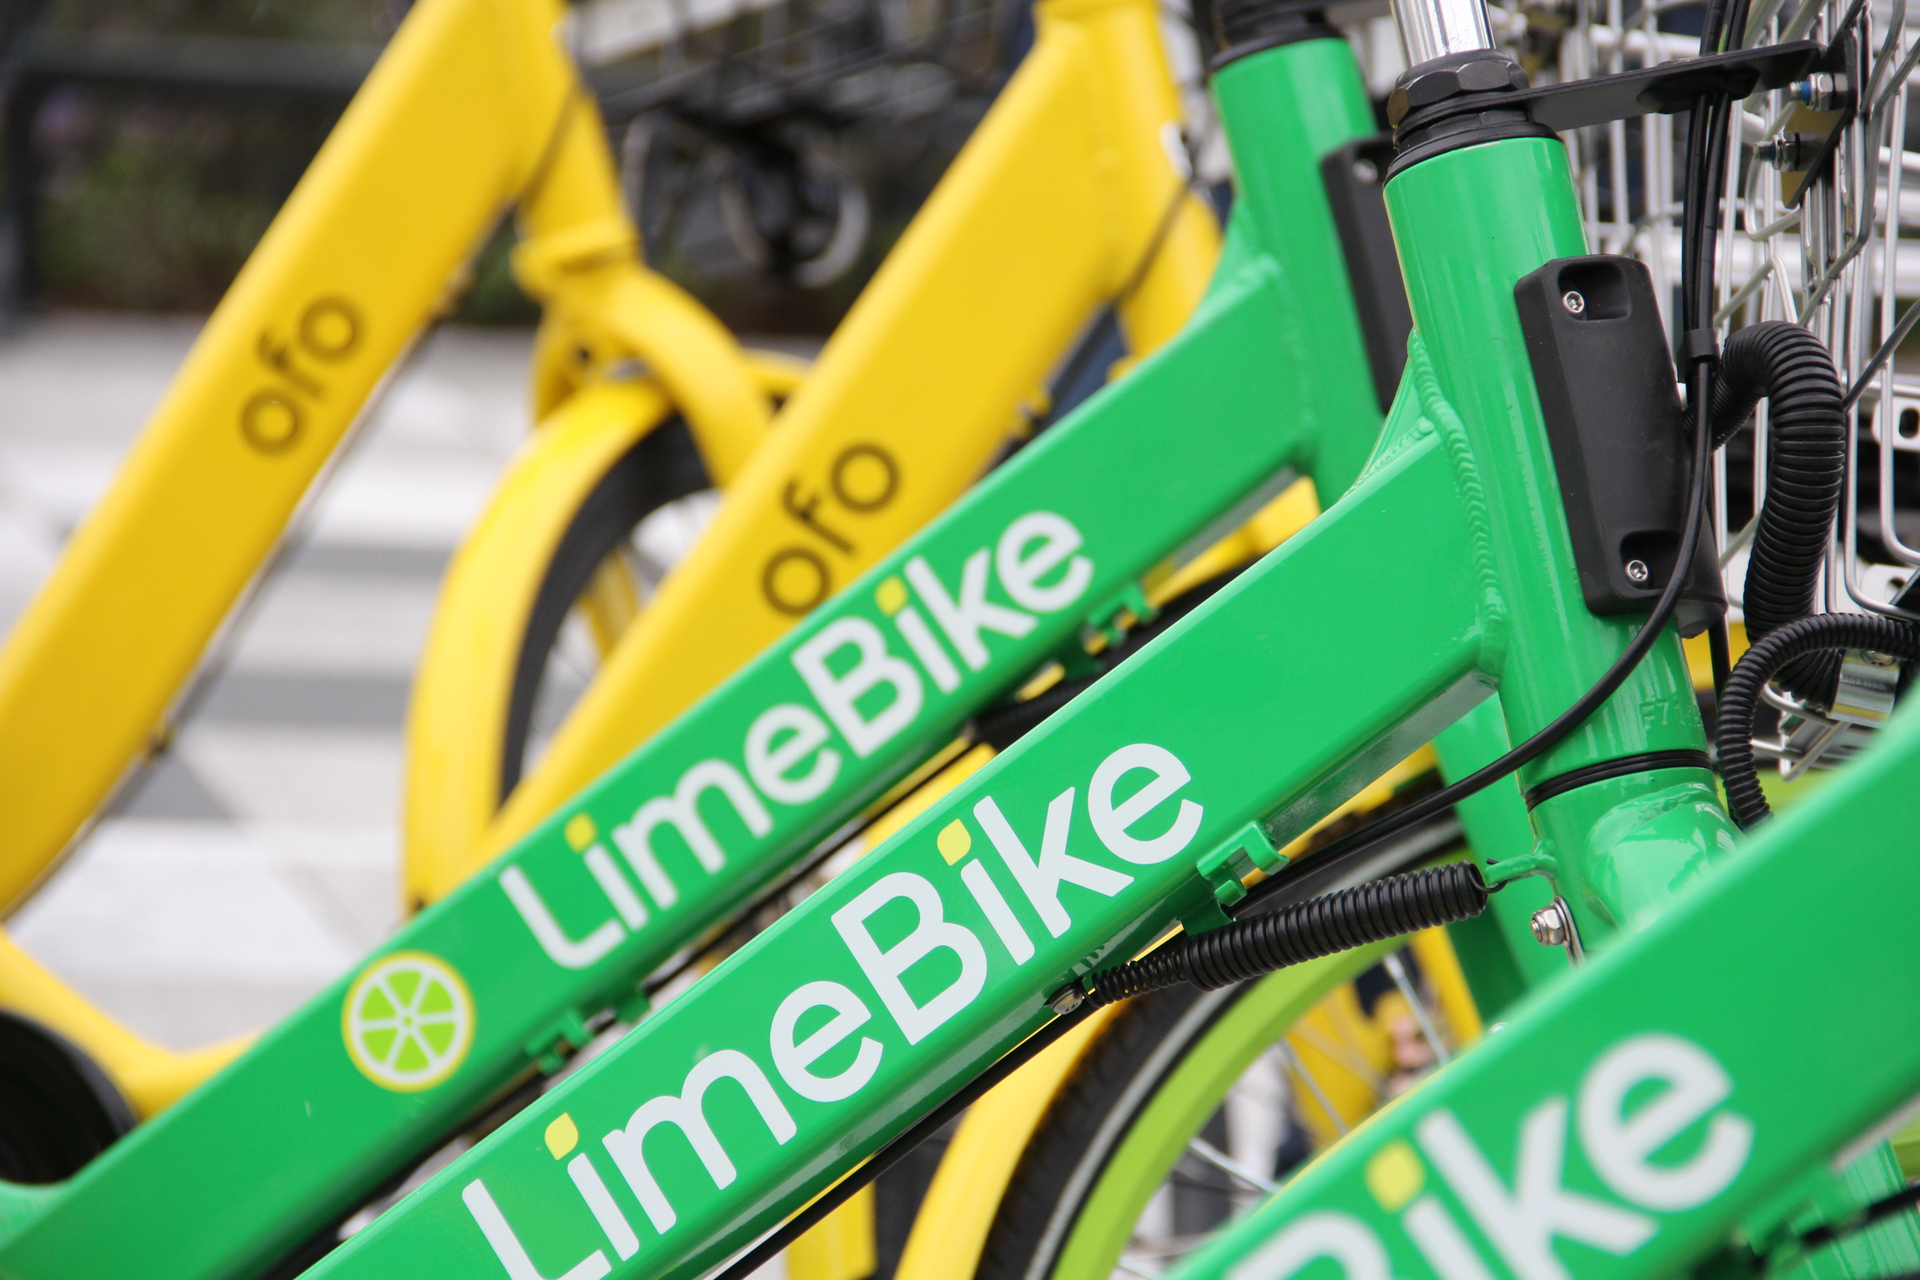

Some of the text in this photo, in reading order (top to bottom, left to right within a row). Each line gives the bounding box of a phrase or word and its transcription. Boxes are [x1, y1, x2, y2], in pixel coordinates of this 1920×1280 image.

[241, 295, 364, 454] ofo
[762, 444, 899, 615] ofo
[500, 511, 1094, 969] LimeBike
[461, 742, 1204, 1280] LimeBike
[1218, 1034, 1754, 1280] ike
